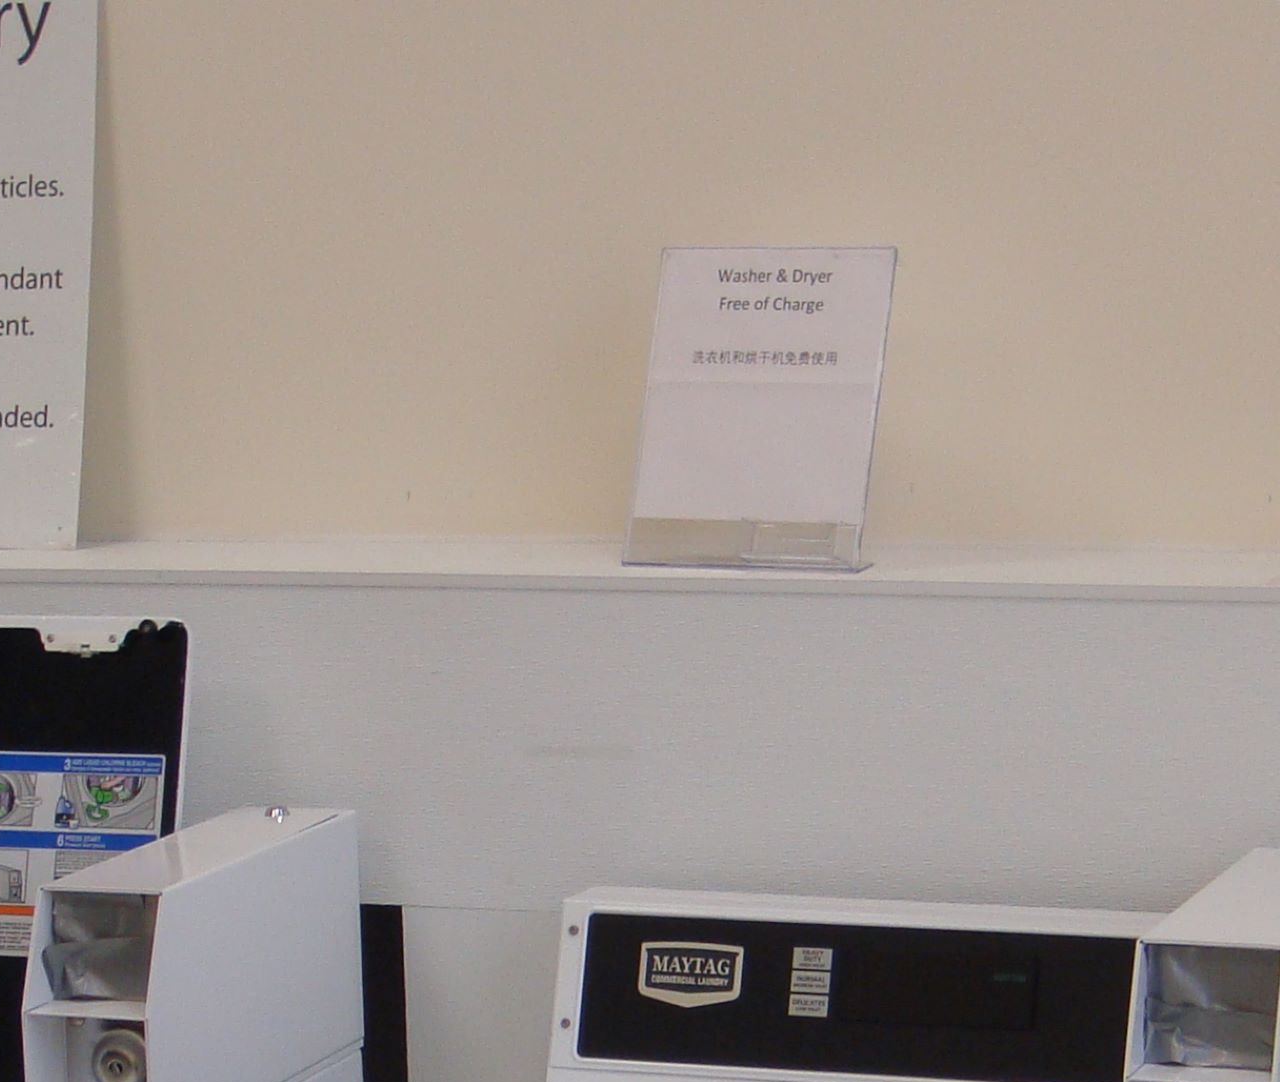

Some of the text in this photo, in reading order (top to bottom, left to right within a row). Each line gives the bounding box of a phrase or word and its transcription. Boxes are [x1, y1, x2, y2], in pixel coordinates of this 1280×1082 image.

[717, 268, 833, 286] Washer & Dryer
[719, 296, 824, 315] Free of Charge
[63, 758, 71, 771] 3
[56, 834, 64, 847] 6
[652, 955, 731, 976] MAYTAG
[651, 974, 729, 987] COMMERCIAL LAUNDRY
